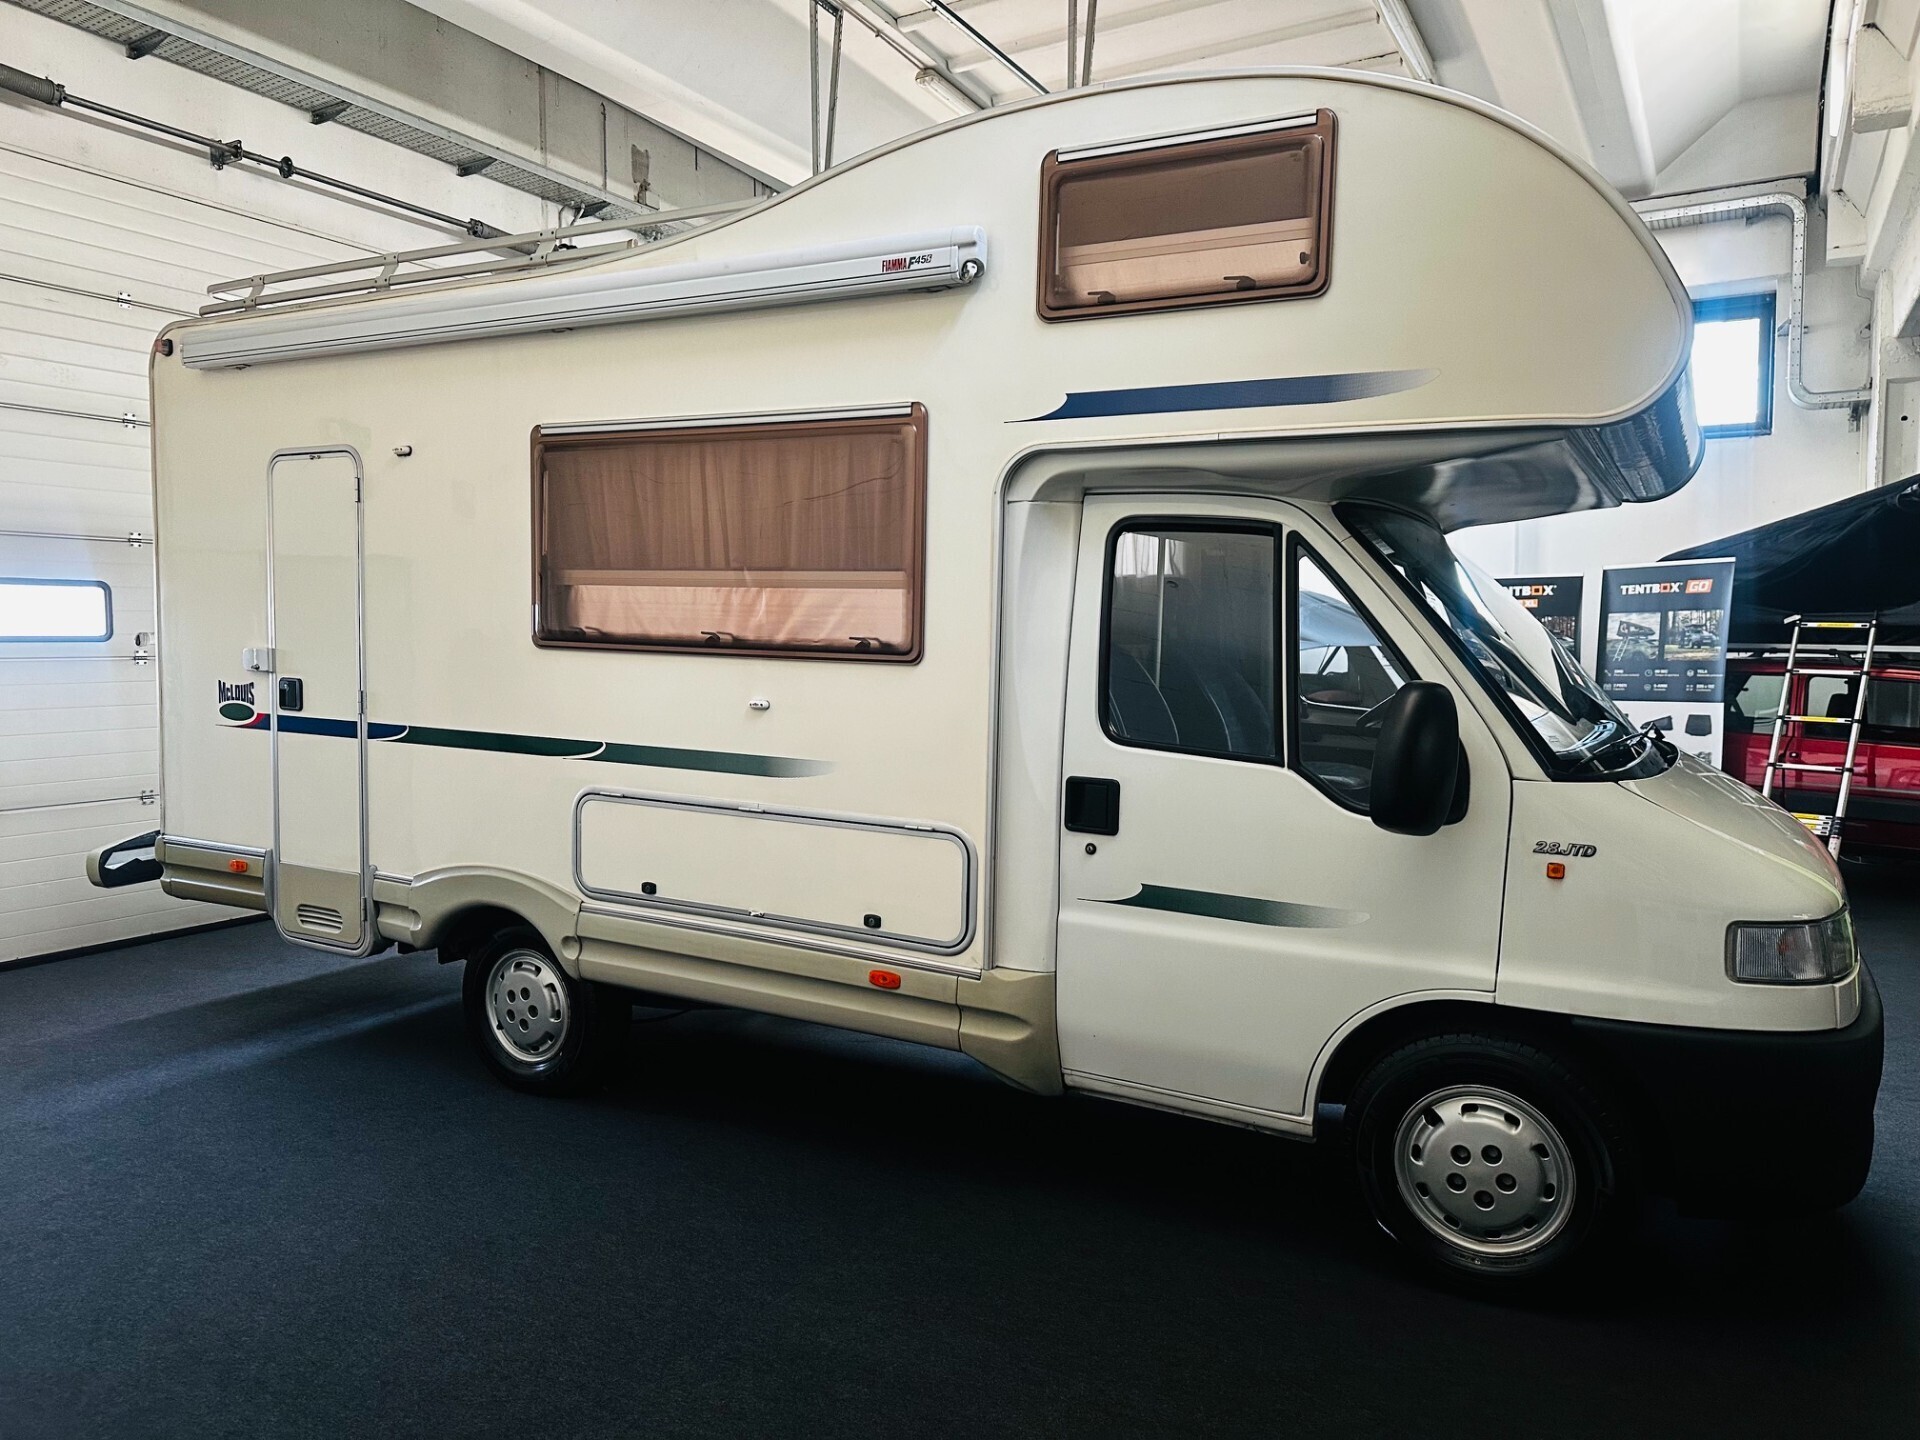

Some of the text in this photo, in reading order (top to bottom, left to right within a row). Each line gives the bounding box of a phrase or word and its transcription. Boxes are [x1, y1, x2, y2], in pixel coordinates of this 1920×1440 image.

[881, 257, 907, 273] FIAMMA
[1620, 580, 1710, 595] TENTBOX GO
